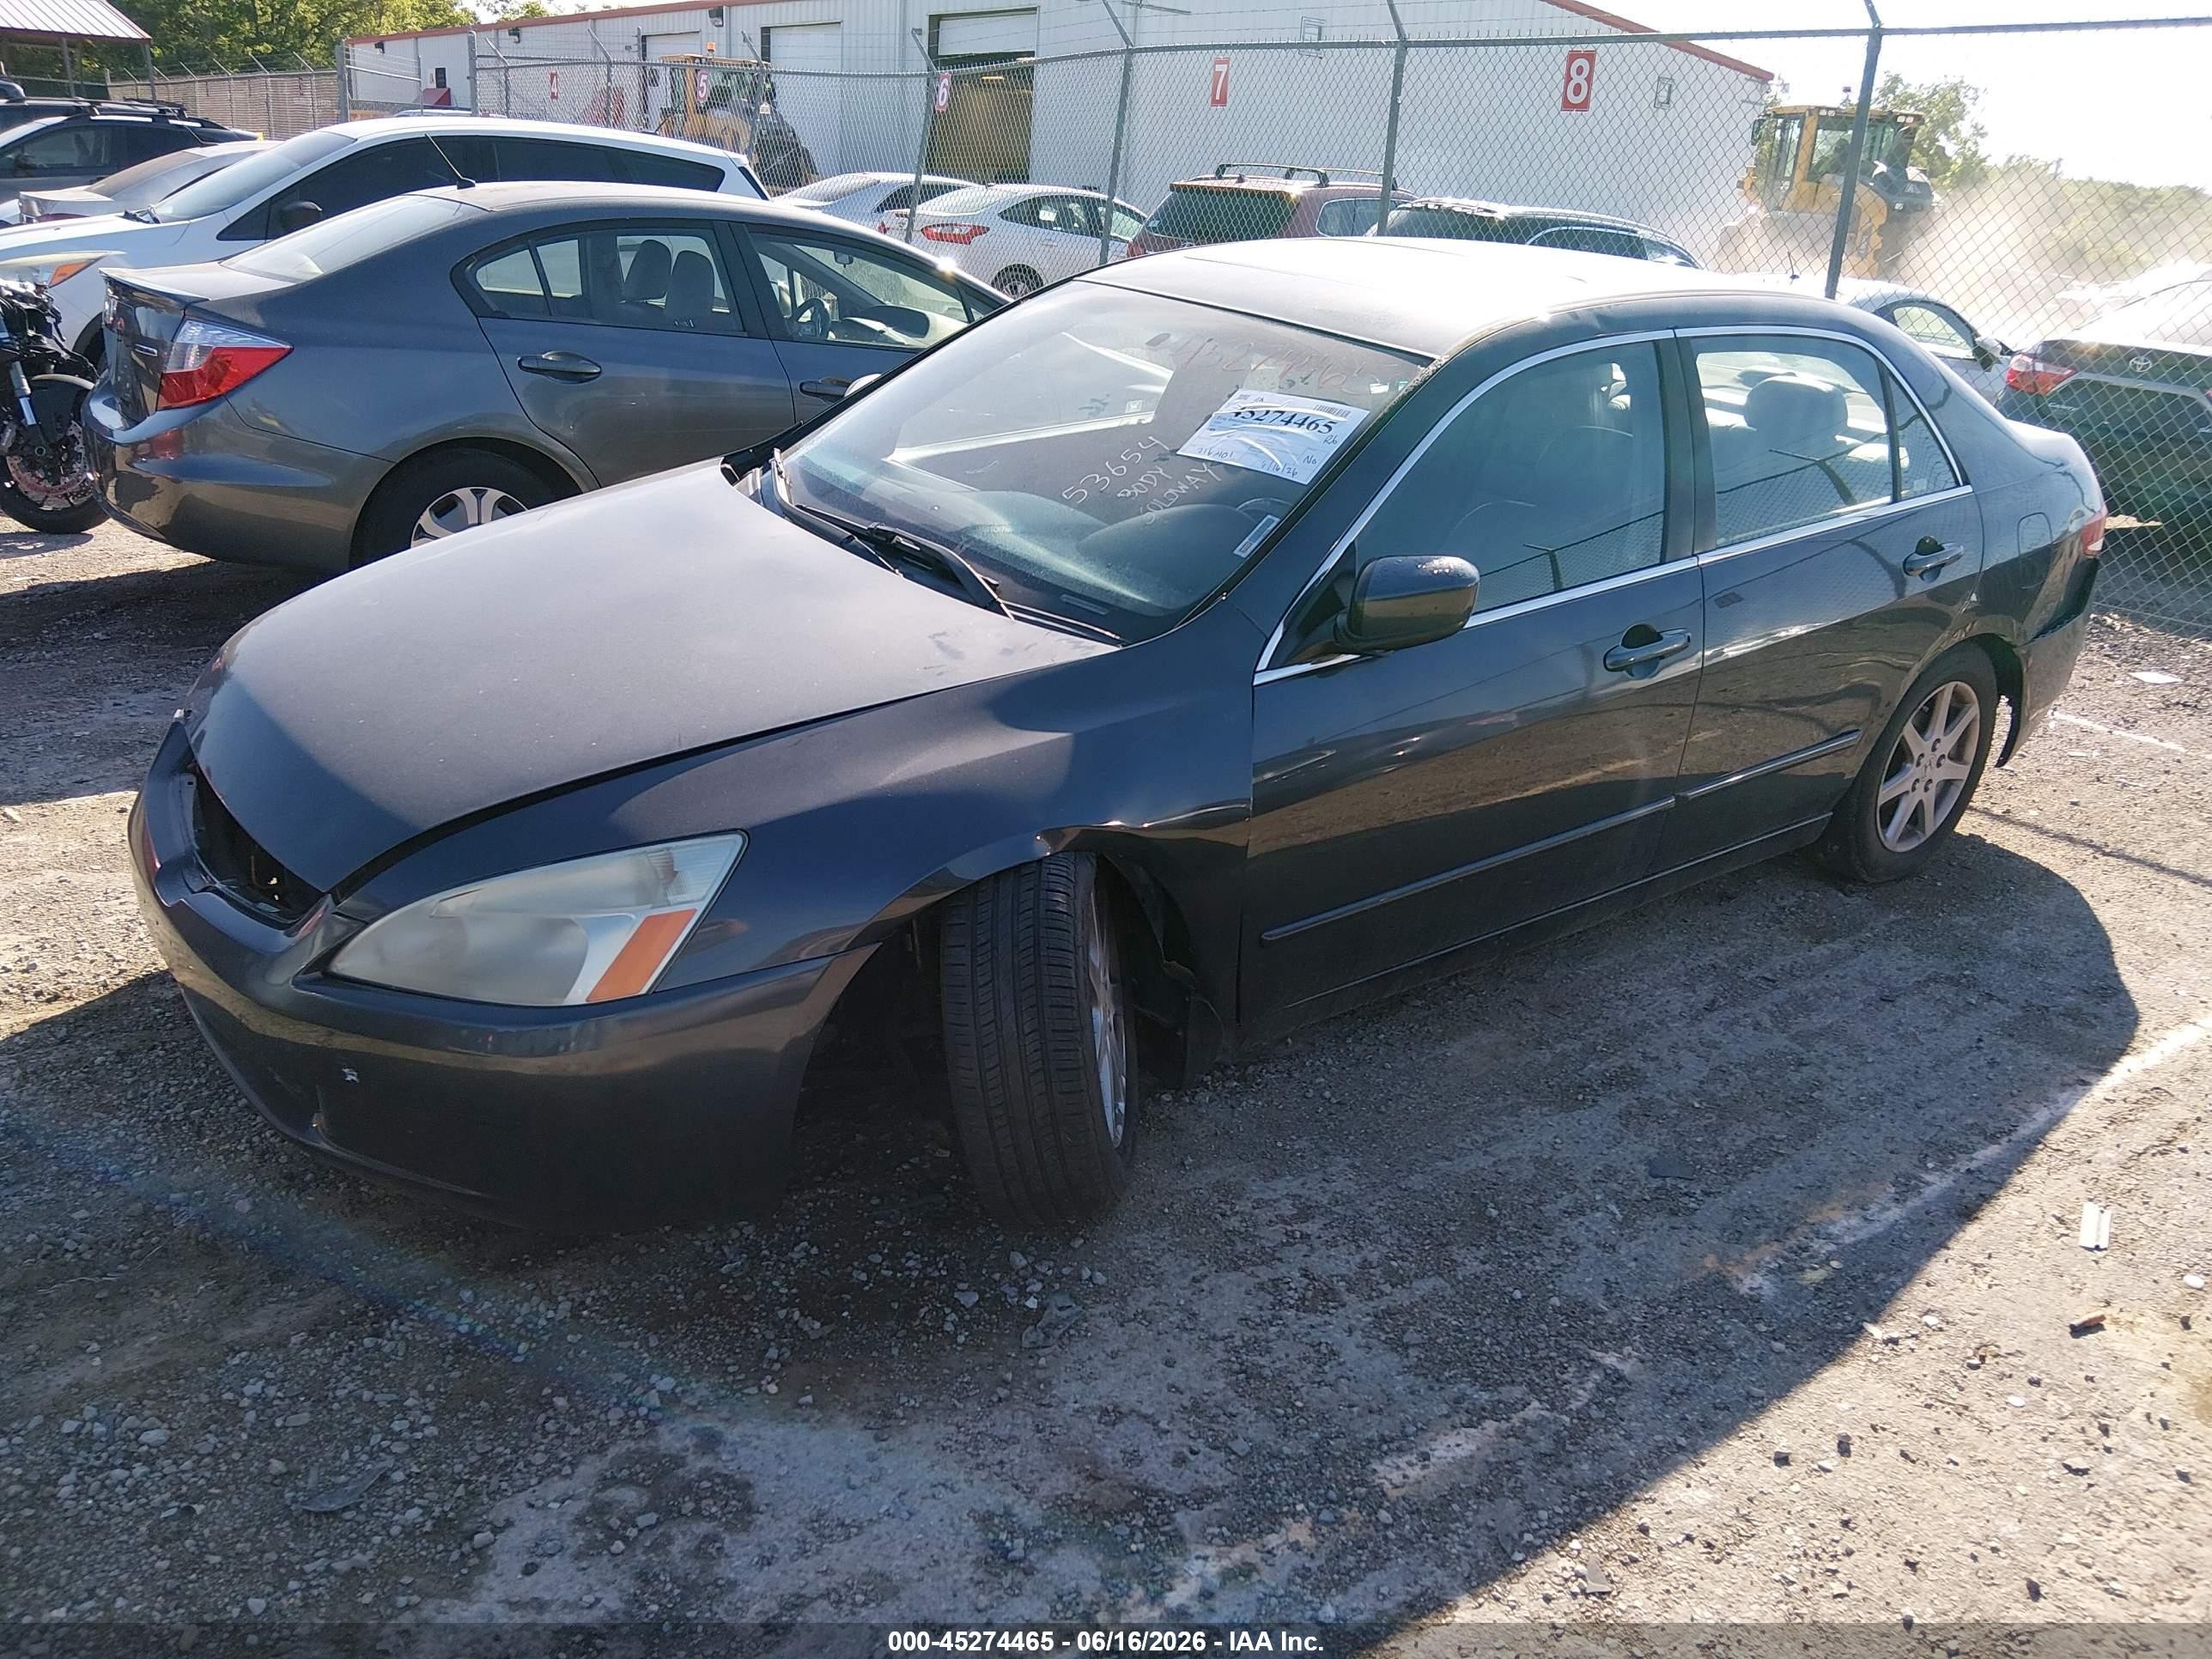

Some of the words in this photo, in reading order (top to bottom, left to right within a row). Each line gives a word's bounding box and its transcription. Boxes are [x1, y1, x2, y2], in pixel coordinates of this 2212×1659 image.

[550, 75, 558, 97] 4
[698, 74, 708, 98] 5
[938, 77, 949, 106] 6
[1214, 64, 1228, 100] 7
[1566, 58, 1590, 105] 8
[1061, 435, 1170, 505] 53654
